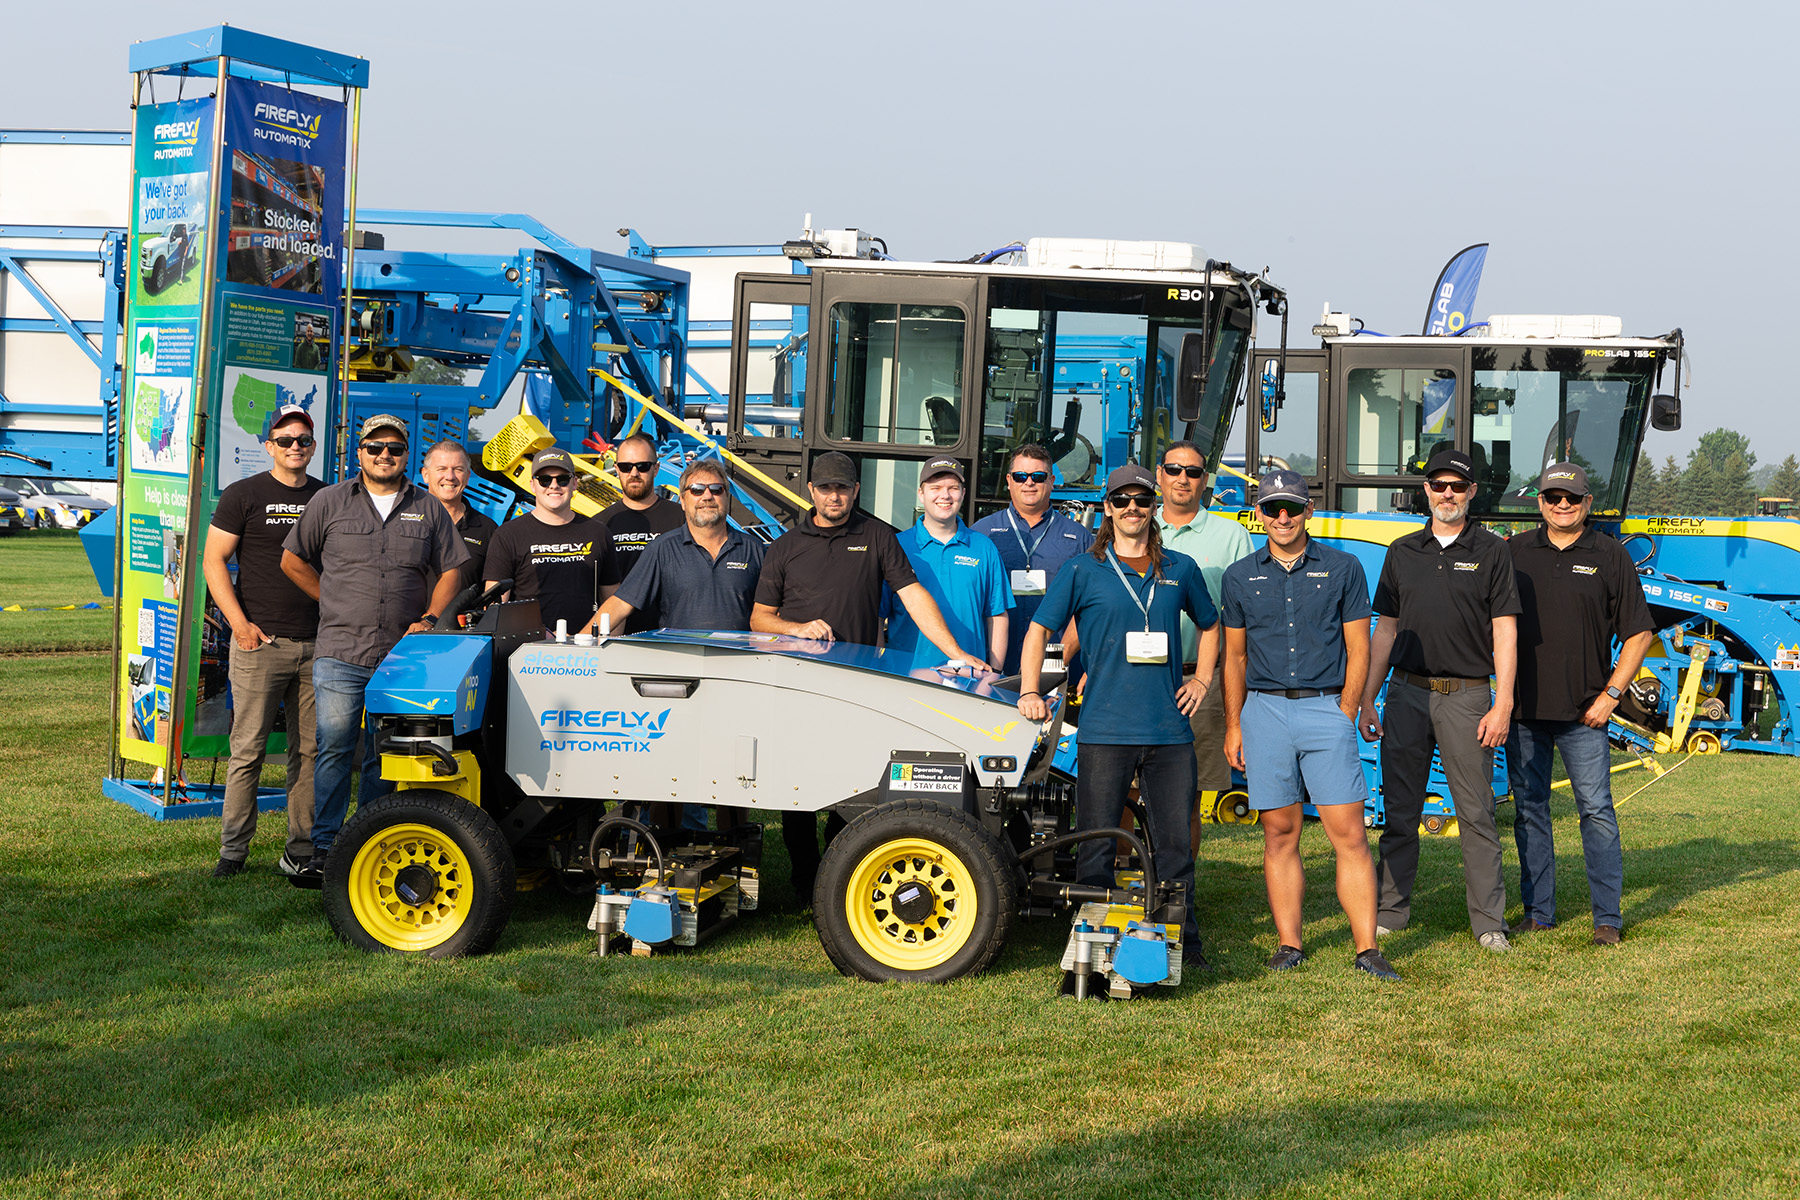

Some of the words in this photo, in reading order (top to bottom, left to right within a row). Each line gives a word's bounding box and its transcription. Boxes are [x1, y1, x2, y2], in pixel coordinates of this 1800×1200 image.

[254, 103, 310, 128] FIREFLY
[154, 121, 195, 140] FIREFLY
[254, 128, 311, 149] AUTOMATIX
[154, 147, 193, 160] AUTOMATIX
[146, 182, 171, 198] We've
[174, 181, 187, 200] got
[145, 208, 165, 224] your
[168, 202, 188, 219] back.
[264, 209, 316, 234] Stocked
[263, 235, 287, 252] and
[290, 236, 336, 259] loaded.
[1584, 349, 1630, 357] PROSLAB
[145, 486, 162, 507] Help
[163, 488, 170, 505] is
[160, 509, 175, 528] than
[1647, 517, 1705, 526] FIREFLY
[530, 543, 583, 553] FIREFLY
[532, 555, 585, 564] AUTOMATIX
[1669, 589, 1702, 604] 155C
[522, 651, 600, 668] electric
[520, 666, 597, 676] AUTONOMOUS
[465, 689, 477, 712] AV
[541, 710, 650, 727] FIREFLY
[540, 740, 651, 752] AUTOMATIX
